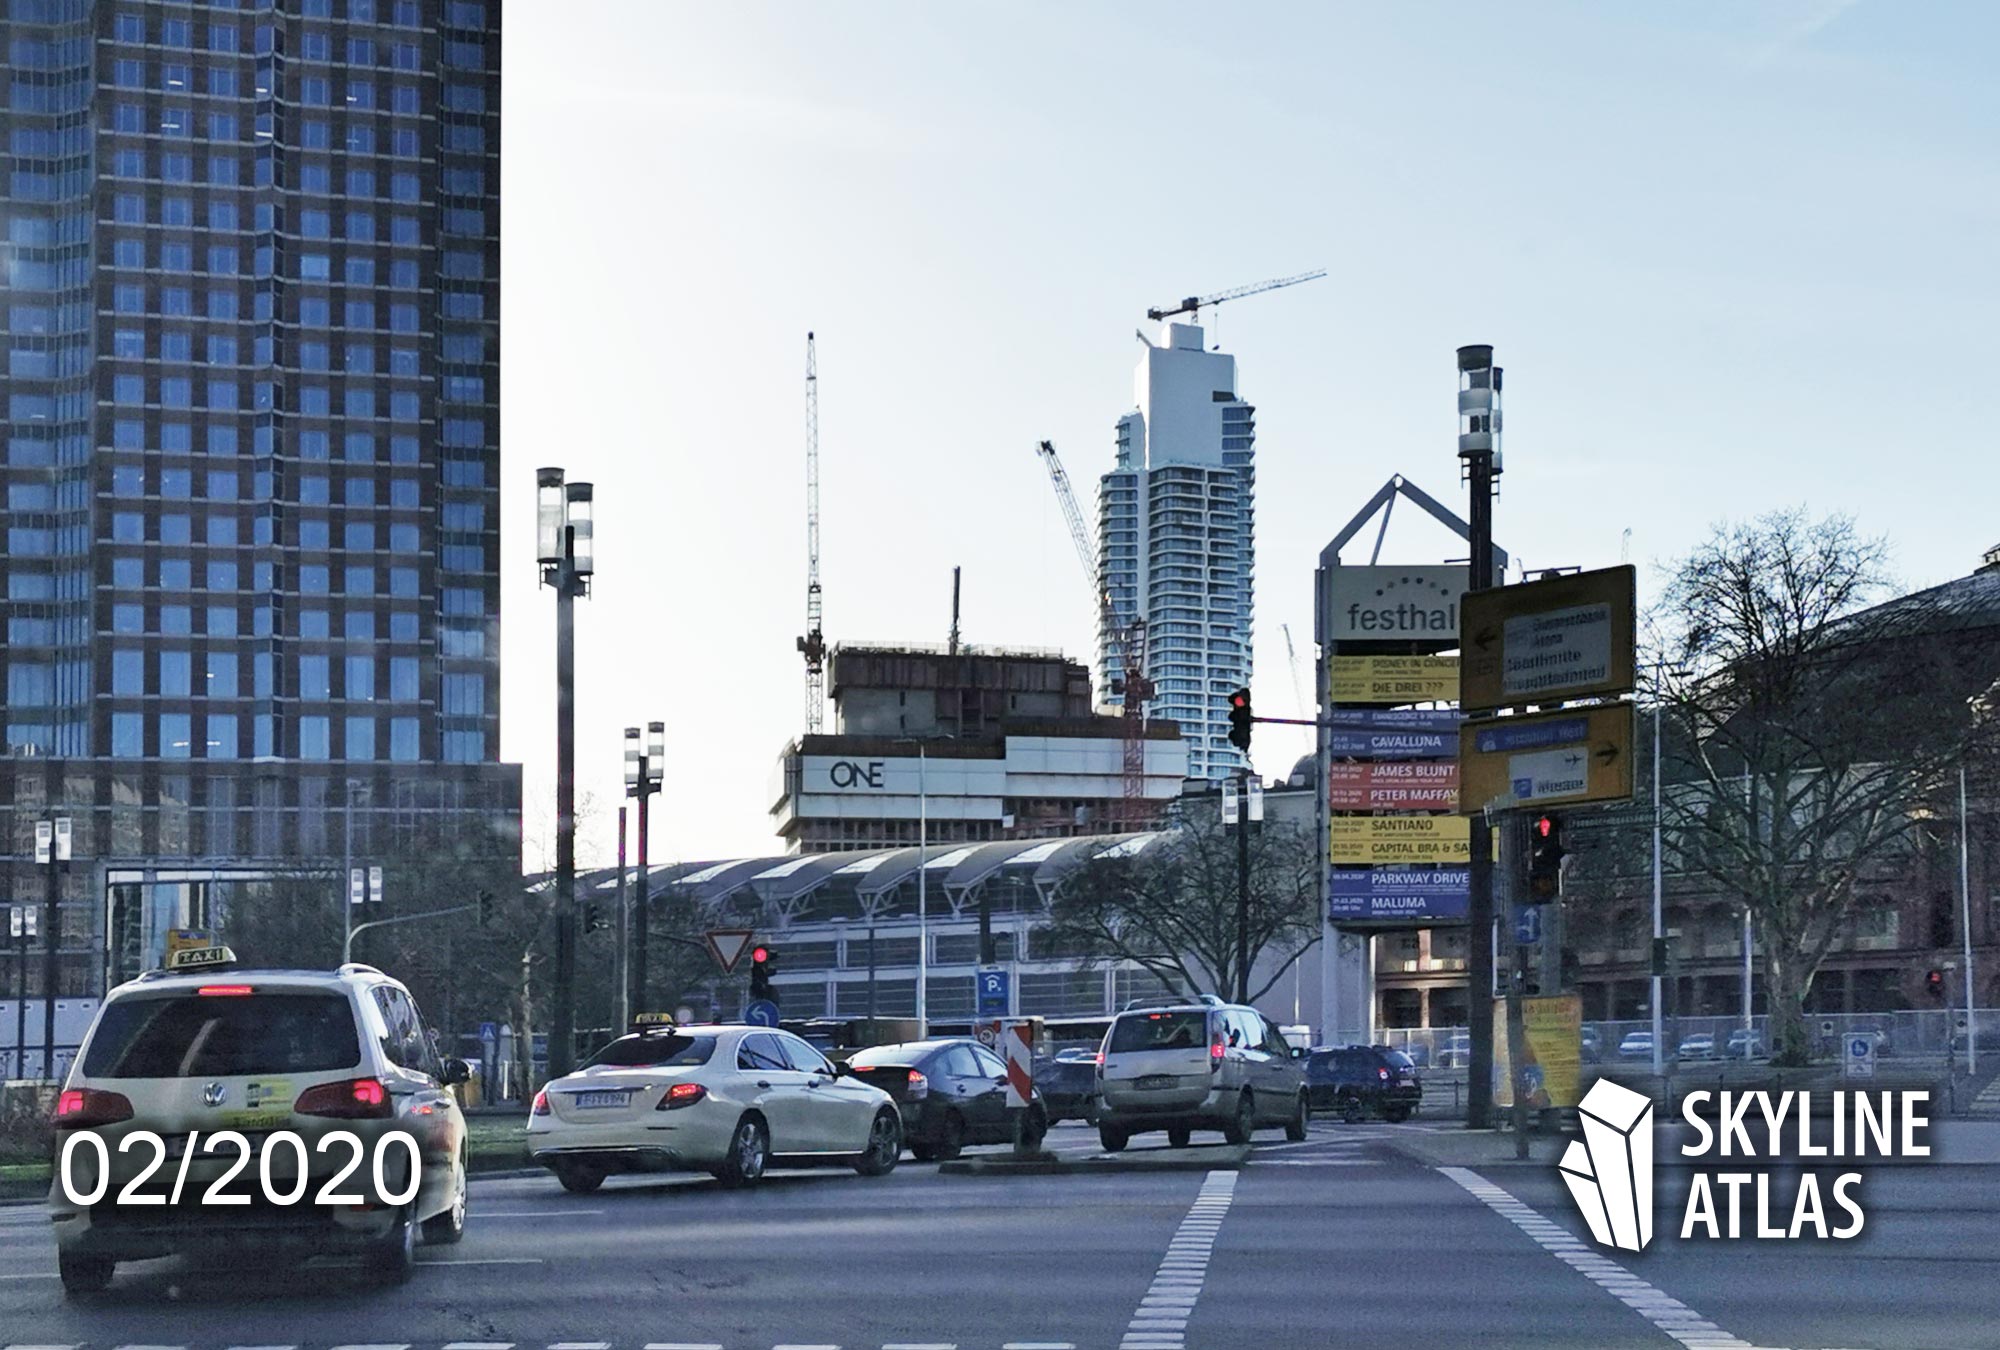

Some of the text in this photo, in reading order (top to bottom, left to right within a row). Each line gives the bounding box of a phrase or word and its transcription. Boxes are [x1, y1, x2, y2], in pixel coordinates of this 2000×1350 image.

[1347, 603, 1455, 630] festhal
[1372, 659, 1407, 668] DISNEY
[1410, 659, 1421, 668] IN
[1372, 682, 1392, 692] DIE
[1395, 682, 1422, 692] DREI
[1425, 682, 1444, 692] ???
[1371, 736, 1442, 747] CAVALLUNA
[830, 761, 884, 788] ONE
[1371, 765, 1413, 776] JAMES
[1416, 765, 1455, 776] BLUNT
[1370, 789, 1406, 800] PETER
[1410, 789, 1459, 800] MAFFAY
[1372, 820, 1433, 831] SANTIANO
[1371, 843, 1413, 853] CAPITAL
[1418, 843, 1439, 853] BRA
[1442, 844, 1450, 853] &
[1371, 872, 1469, 884] PARKWAY DRIVE
[1371, 897, 1426, 908] MALUMA
[180, 950, 220, 962] TAXI
